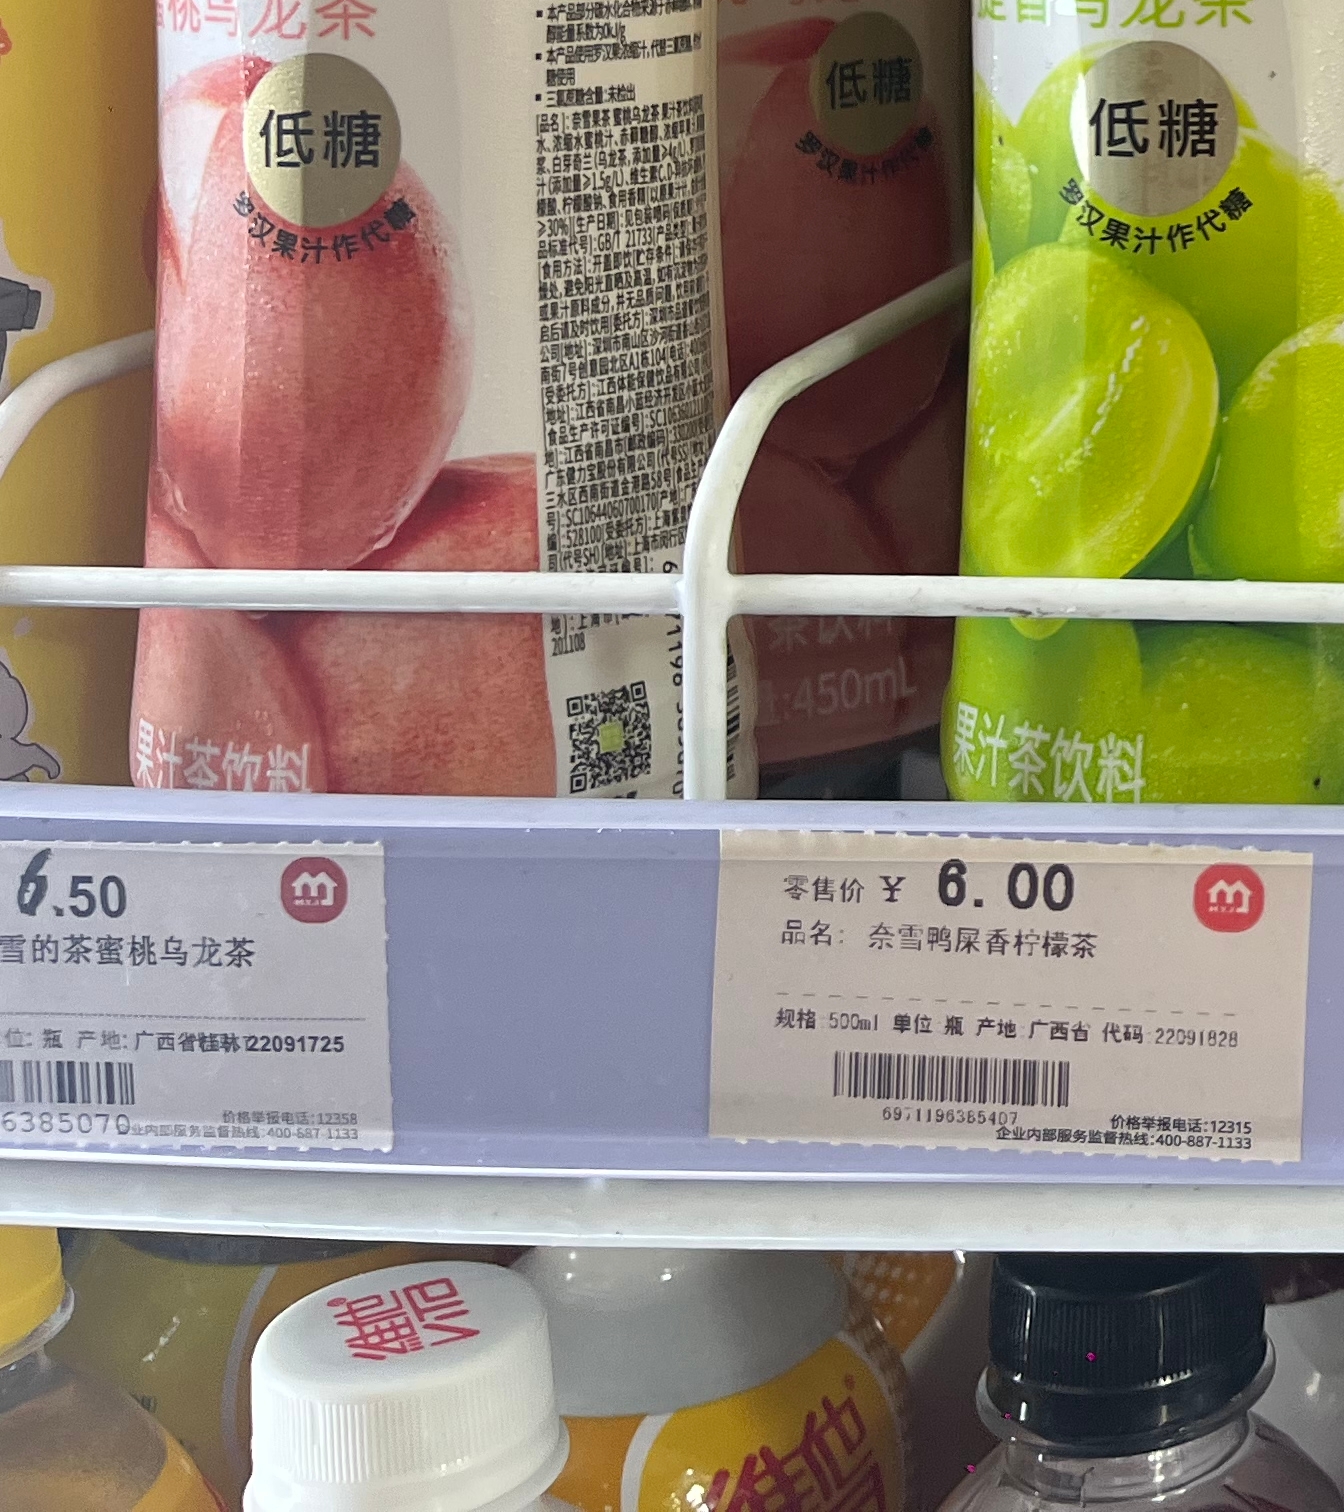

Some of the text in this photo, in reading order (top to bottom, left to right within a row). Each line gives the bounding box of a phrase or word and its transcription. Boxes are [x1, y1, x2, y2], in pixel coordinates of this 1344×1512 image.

[826, 56, 913, 109] 低糖
[259, 109, 381, 169] 低糖
[1089, 98, 1219, 159] 低糖
[953, 701, 1145, 804] 果汁茶饮料
[783, 859, 1075, 912] 零售价 6.00
[868, 924, 1098, 959] 奈雪鸭屎香柠檬茶
[248, 1036, 344, 1053] 22091725
